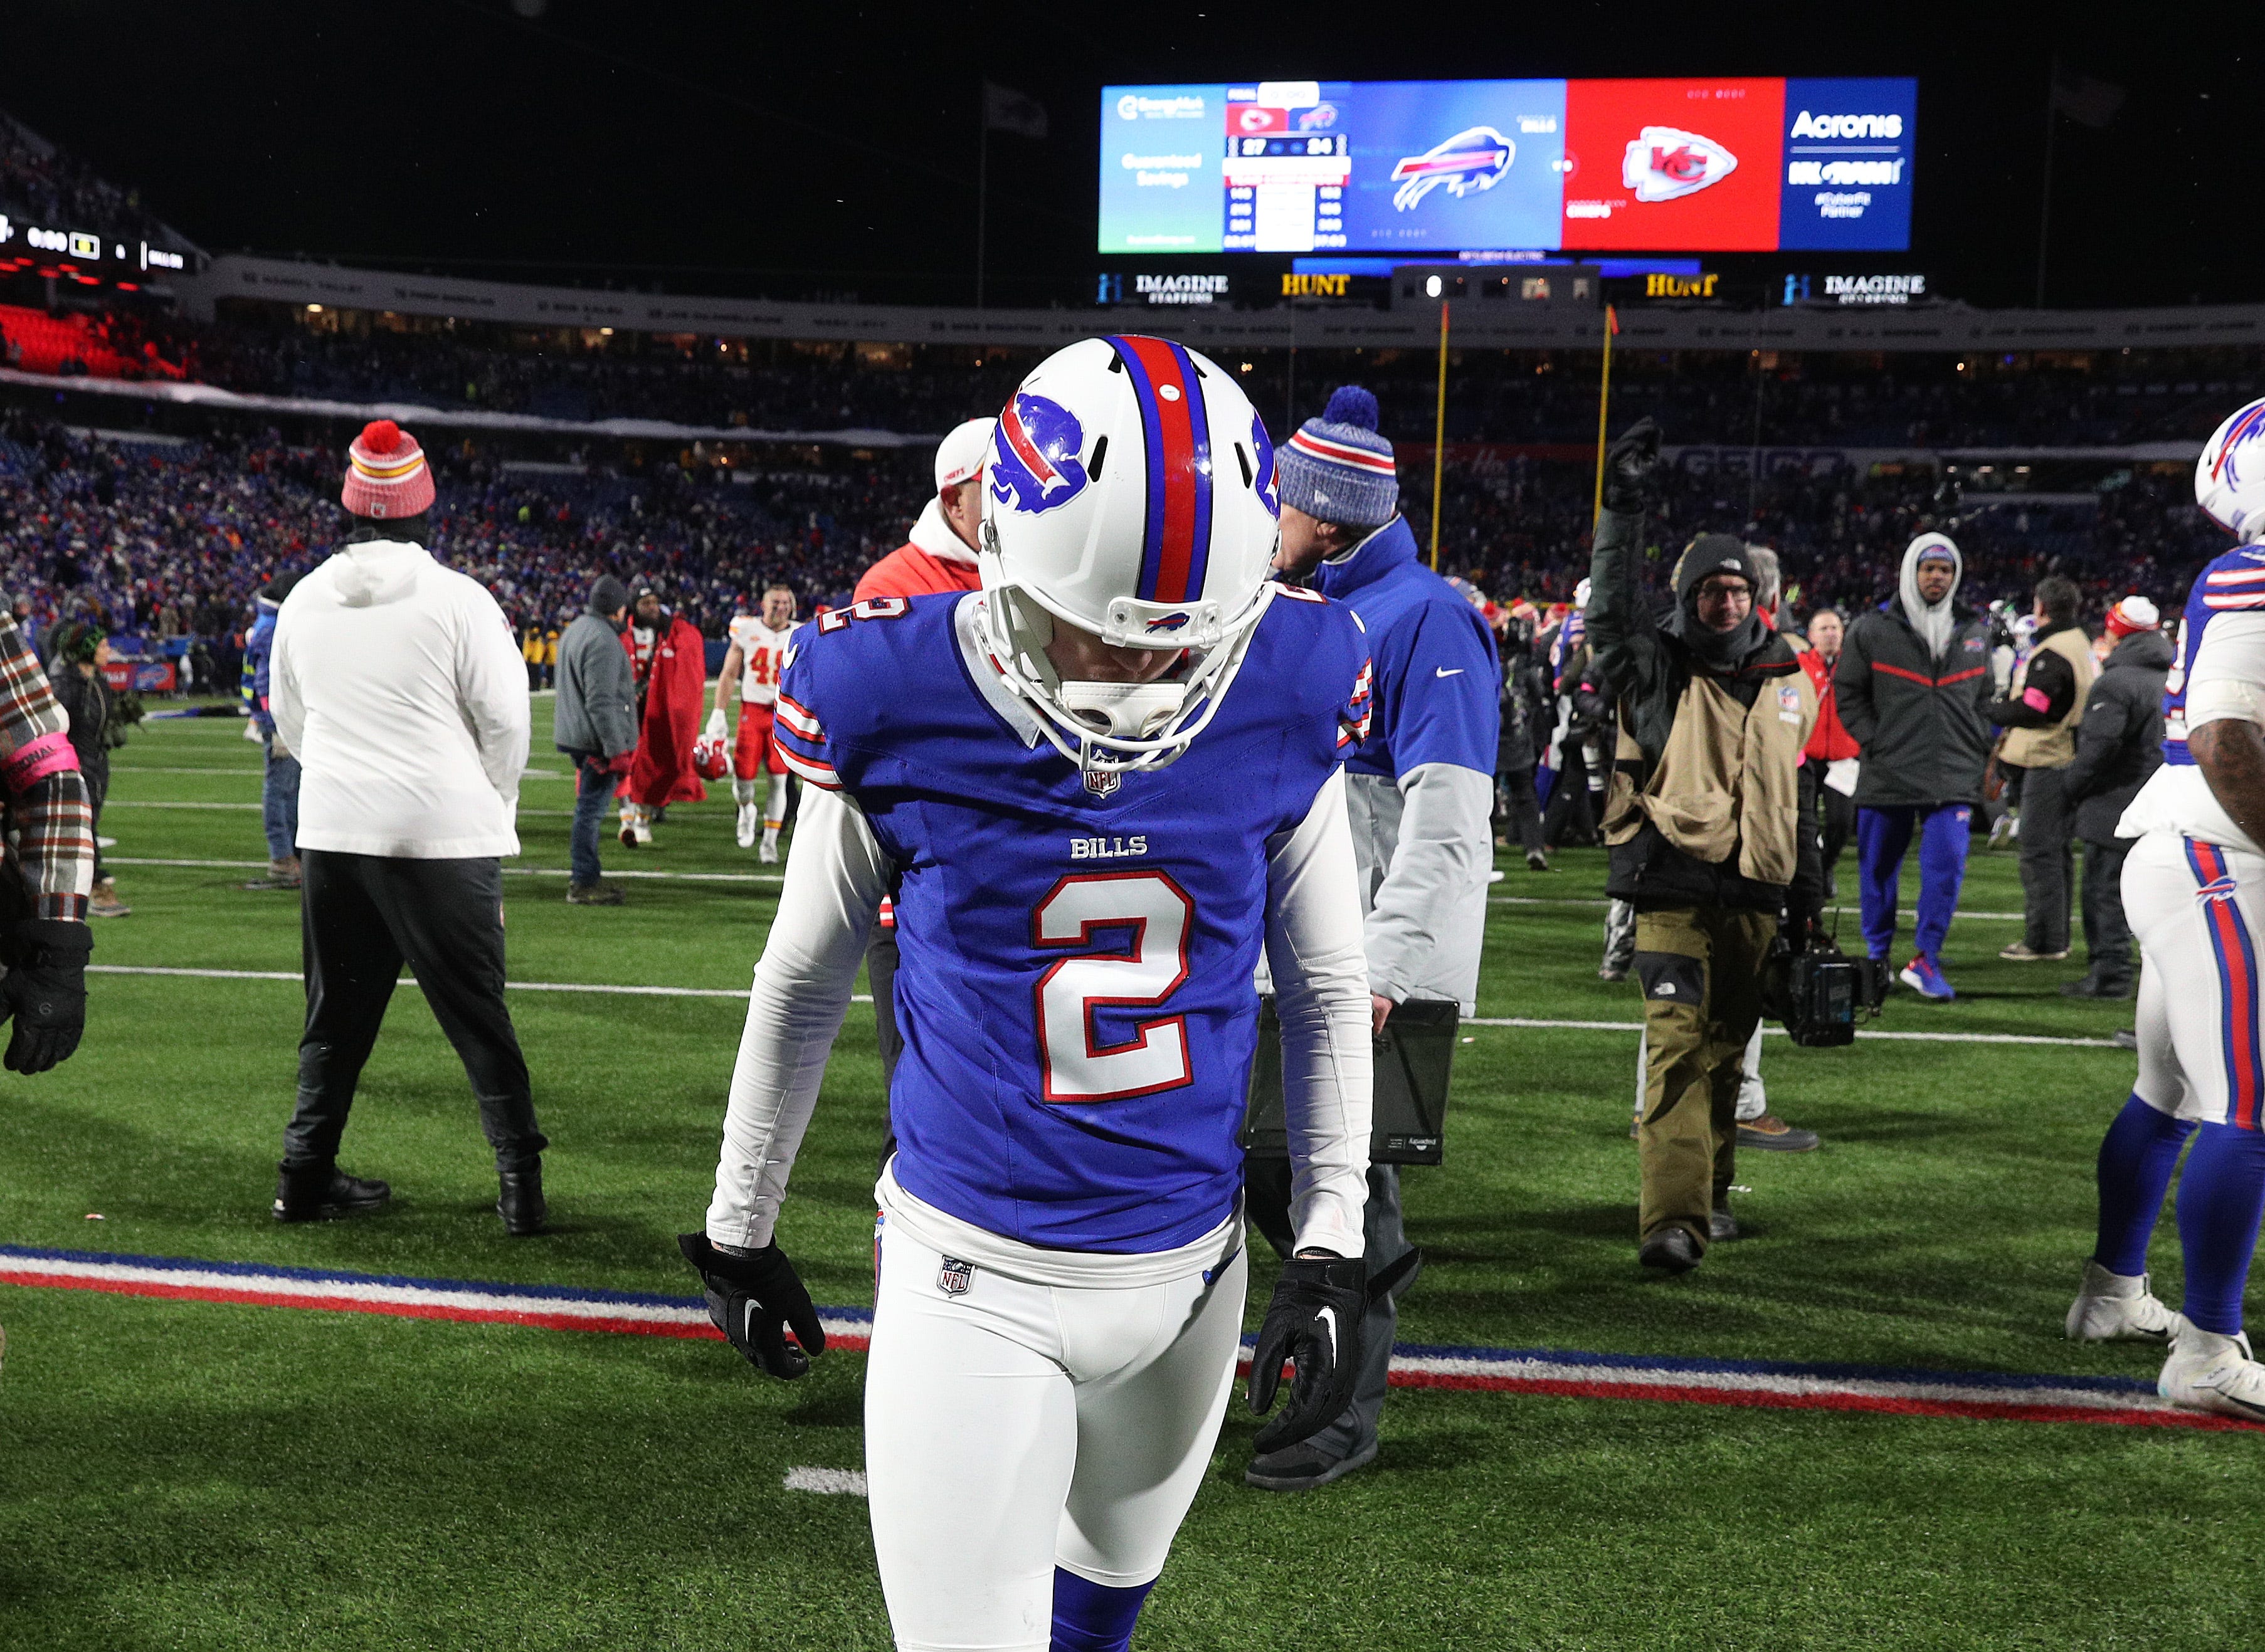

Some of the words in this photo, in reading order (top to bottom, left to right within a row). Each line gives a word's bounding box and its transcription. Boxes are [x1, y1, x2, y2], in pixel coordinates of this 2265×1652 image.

[1790, 110, 1903, 139] Acronis
[1135, 274, 1229, 293] IMAGINE
[1281, 273, 1351, 297] HUNT
[1824, 275, 1926, 295] IMAGINE
[1089, 771, 1115, 789] NFL
[1070, 835, 1148, 860] BILLS
[1032, 868, 1194, 1103] 2
[941, 1271, 965, 1290] NFL
